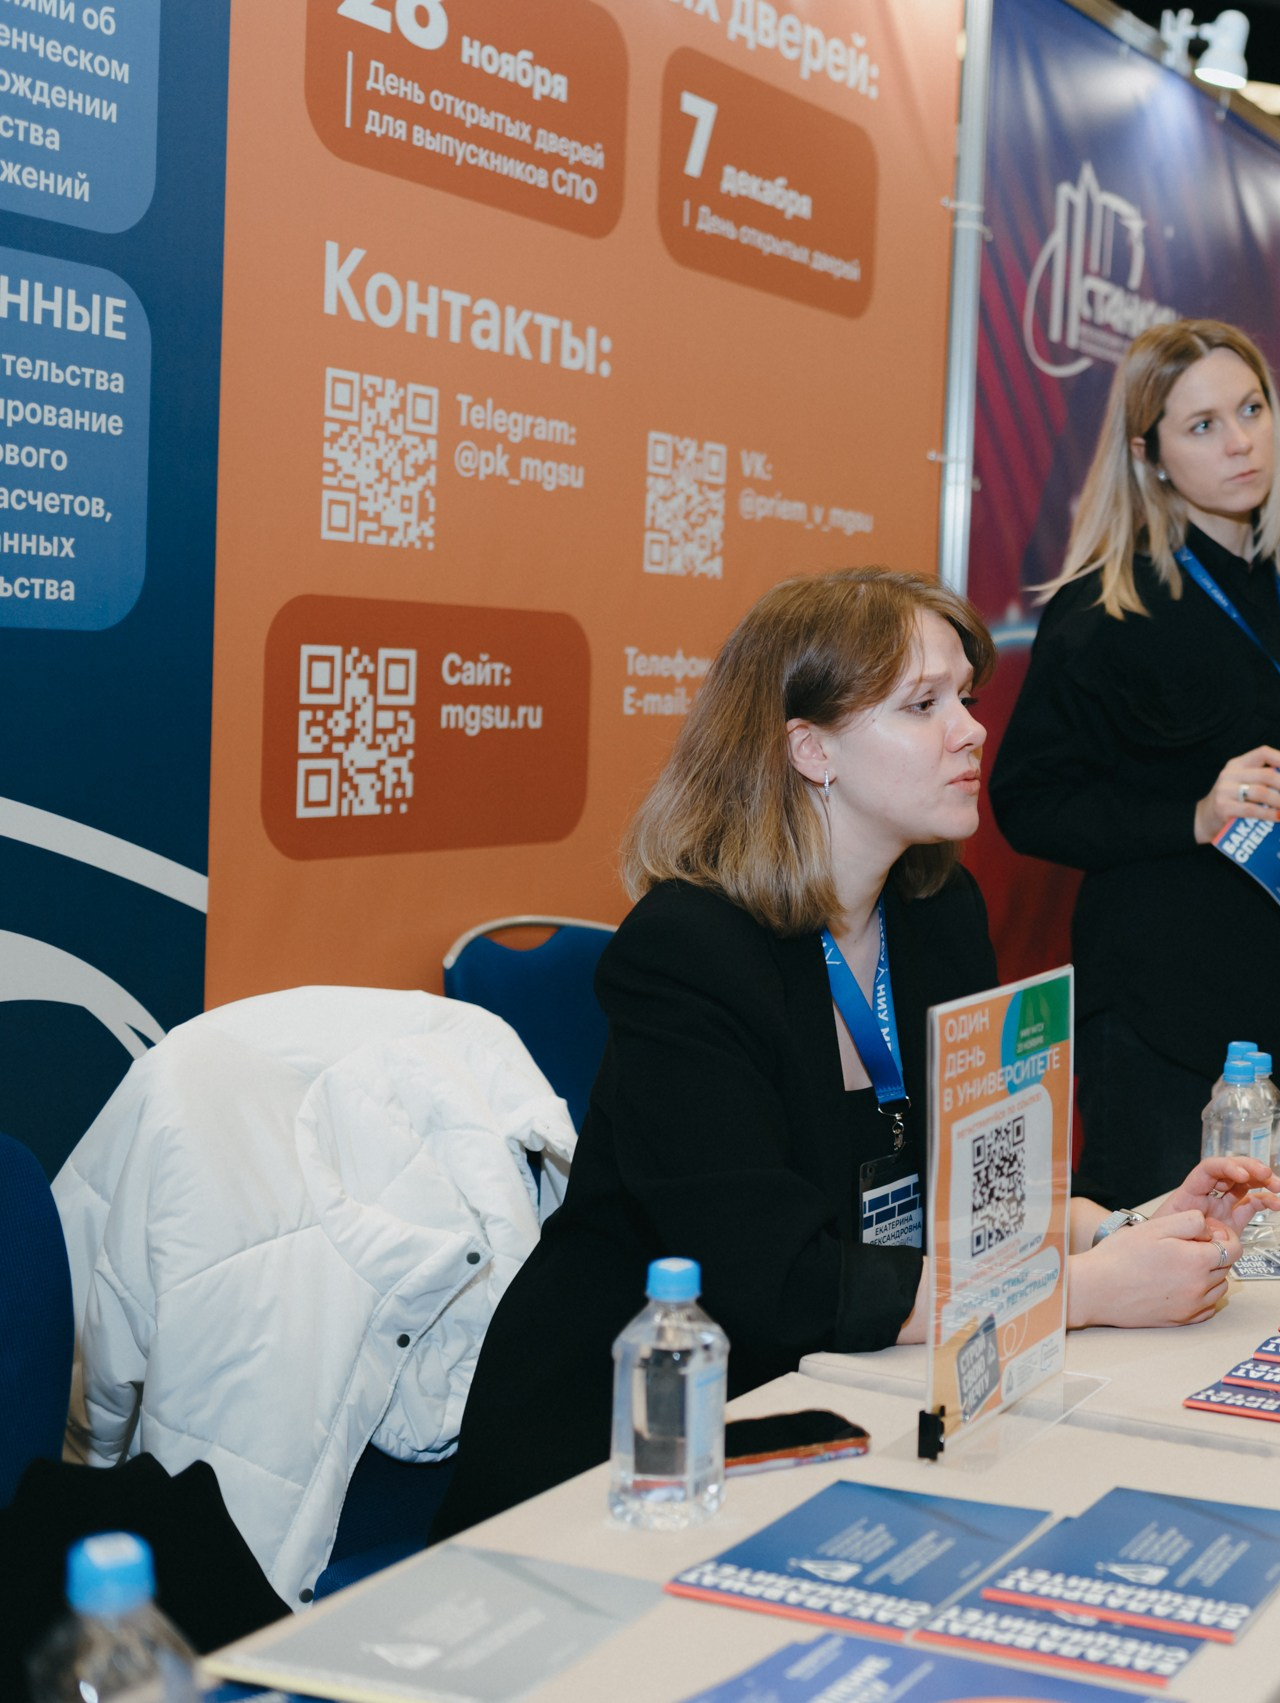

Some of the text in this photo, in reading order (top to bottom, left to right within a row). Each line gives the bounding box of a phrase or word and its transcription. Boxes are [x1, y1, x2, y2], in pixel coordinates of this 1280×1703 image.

[82, 6, 116, 36] об
[461, 35, 568, 102] ноября
[728, 0, 879, 100] дверей:
[0, 115, 60, 151] ства
[366, 60, 605, 169] День открытых дверей
[680, 90, 718, 179] 7
[365, 109, 598, 205] для выпускников СПО
[0, 159, 90, 202] жений
[720, 164, 812, 220] декабря
[0, 275, 127, 341] ННЫЕ
[324, 240, 612, 378] Контакты:
[2, 354, 125, 394] тельства
[456, 393, 576, 446] Telegram:
[0, 442, 68, 471] вого
[454, 440, 585, 491] @pk_mgsu
[0, 532, 76, 558] нных
[441, 653, 511, 686] Сайт:
[441, 704, 543, 736] mgsu.ru
[876, 984, 889, 1021] НИУ
[943, 1008, 990, 1043] ОДИН
[943, 1045, 986, 1082] ДЕНЬ
[943, 1047, 1062, 1113] В УНИВЕРСИТЕТЕ
[875, 1214, 914, 1236] ЕКАТЕРИНА
